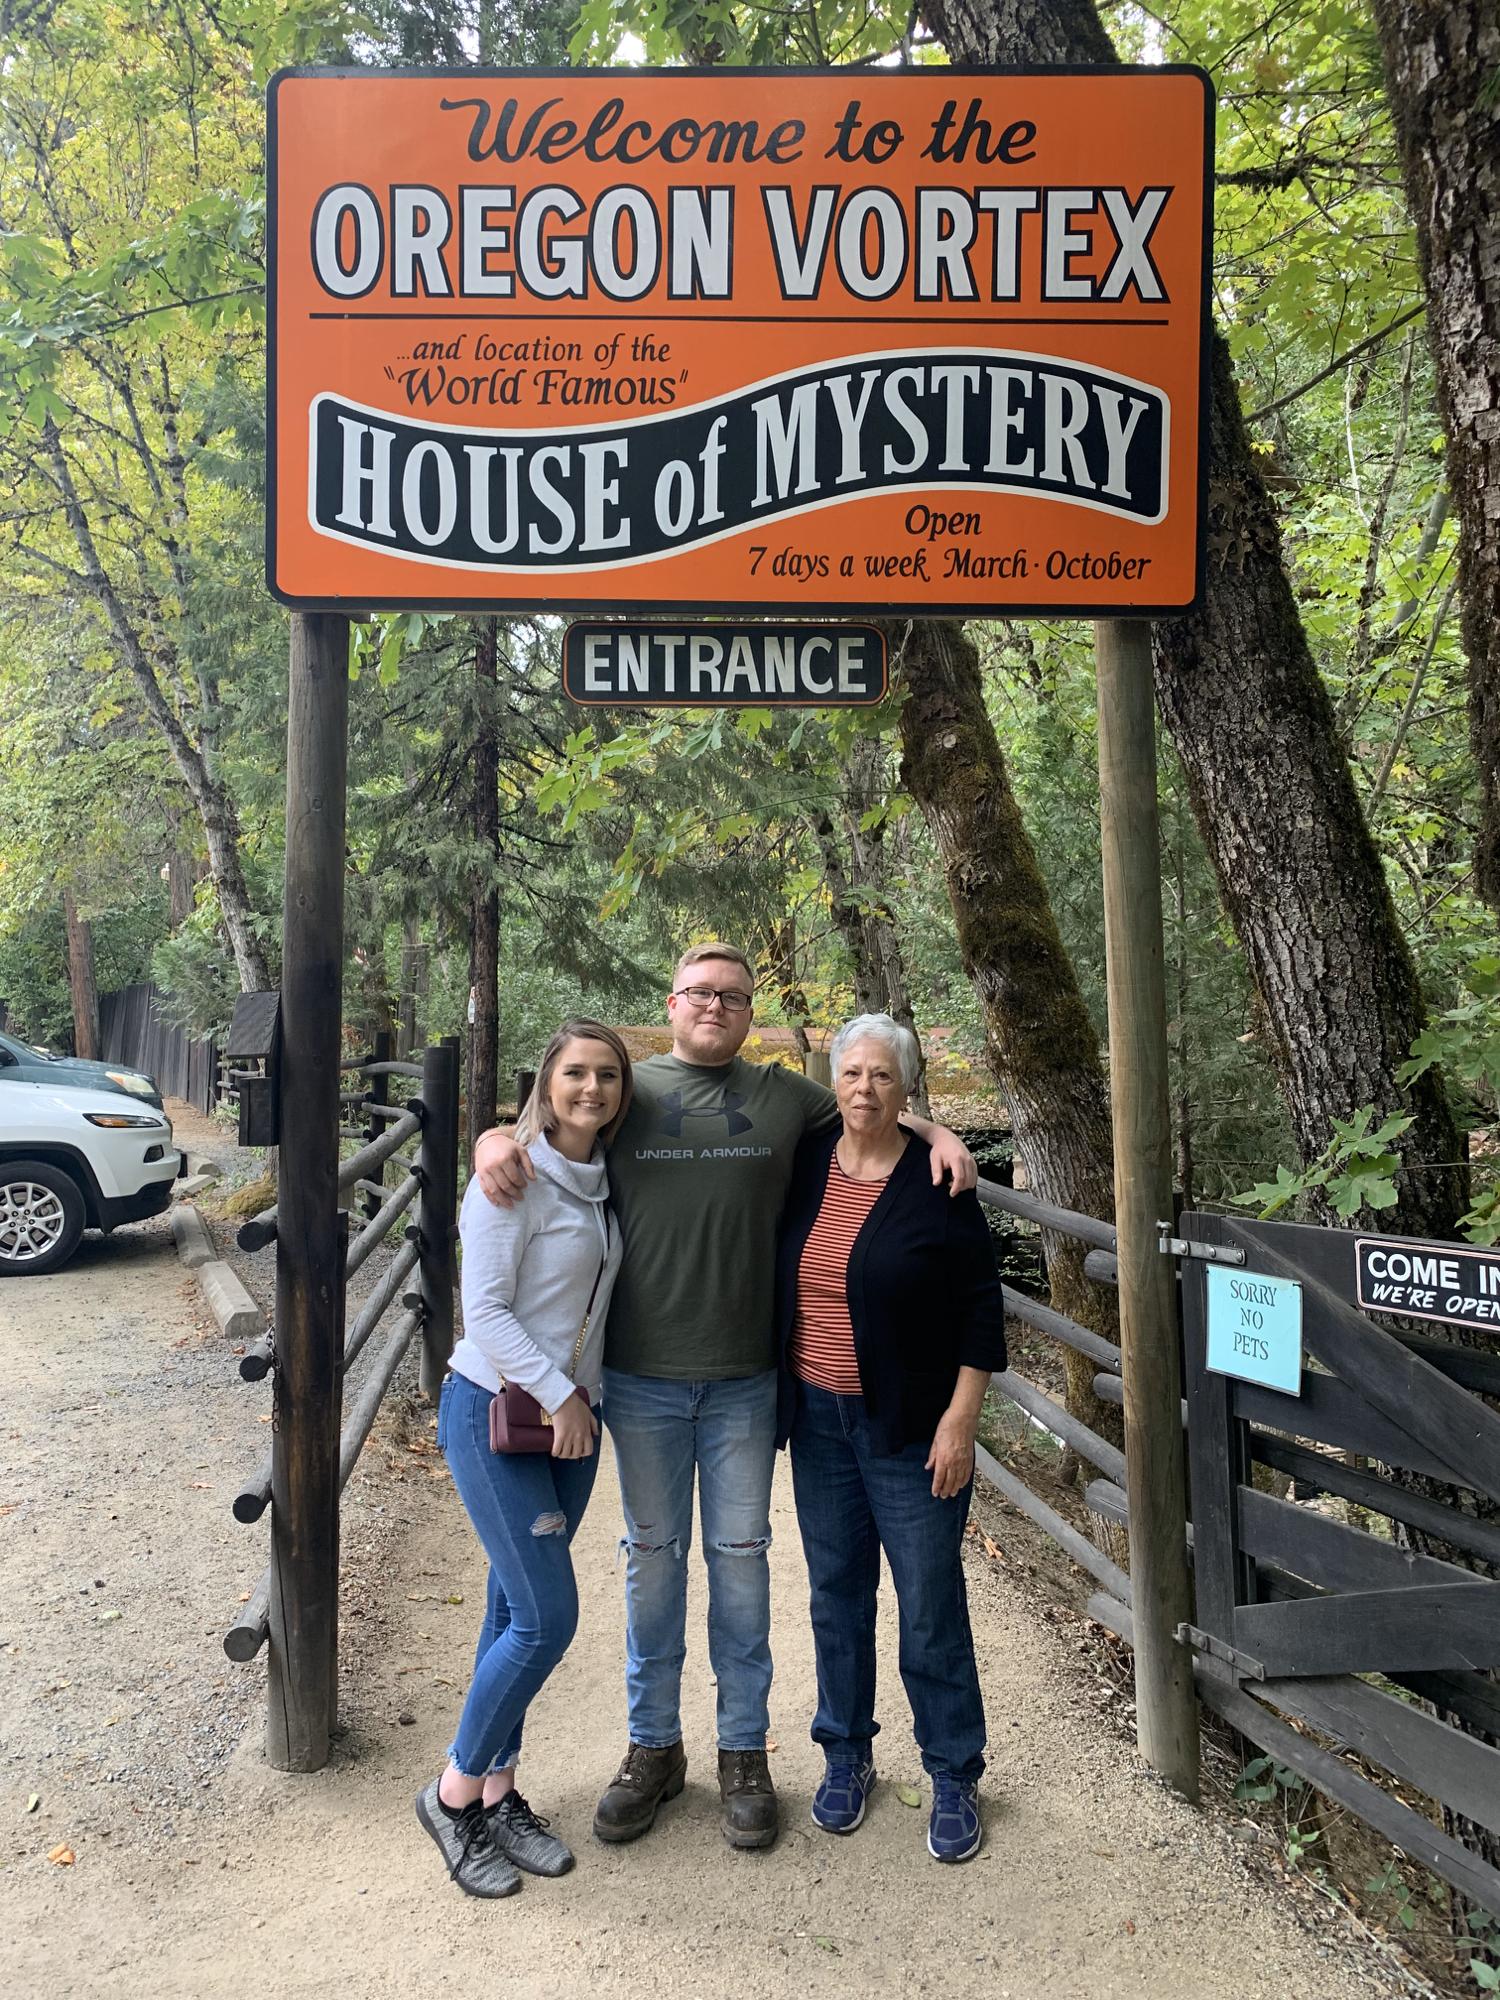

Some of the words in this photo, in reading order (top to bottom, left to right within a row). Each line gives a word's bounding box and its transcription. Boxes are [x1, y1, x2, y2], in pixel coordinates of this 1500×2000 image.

[440, 97, 806, 165] Welcome
[825, 100, 904, 164] to
[920, 98, 1037, 164] the
[311, 182, 735, 302] OREGON
[760, 185, 1175, 304] VORTEX
[475, 333, 584, 361] location
[594, 333, 626, 370] of
[631, 333, 672, 362] the
[383, 365, 527, 406] "World
[533, 369, 689, 405] Famous"
[335, 415, 631, 555] HOUSE
[654, 415, 728, 538] of
[750, 365, 1149, 508] MYSTERY
[905, 504, 982, 542] Open
[748, 546, 768, 577] 7
[772, 547, 829, 584] days
[839, 557, 855, 578] a
[864, 548, 931, 583] week
[943, 547, 1027, 579] March
[1045, 550, 1152, 580] October
[584, 634, 867, 694] ENTRANCE
[635, 1149, 694, 1160] UNDER
[700, 1147, 772, 1159] ARMOUR
[1368, 1251, 1460, 1290] COME
[1230, 1279, 1277, 1307] SORRY
[1372, 1283, 1437, 1309] WE'RE
[1445, 1295, 1500, 1320] OPEN
[1240, 1307, 1264, 1330] NO
[1233, 1331, 1269, 1361] PETS
